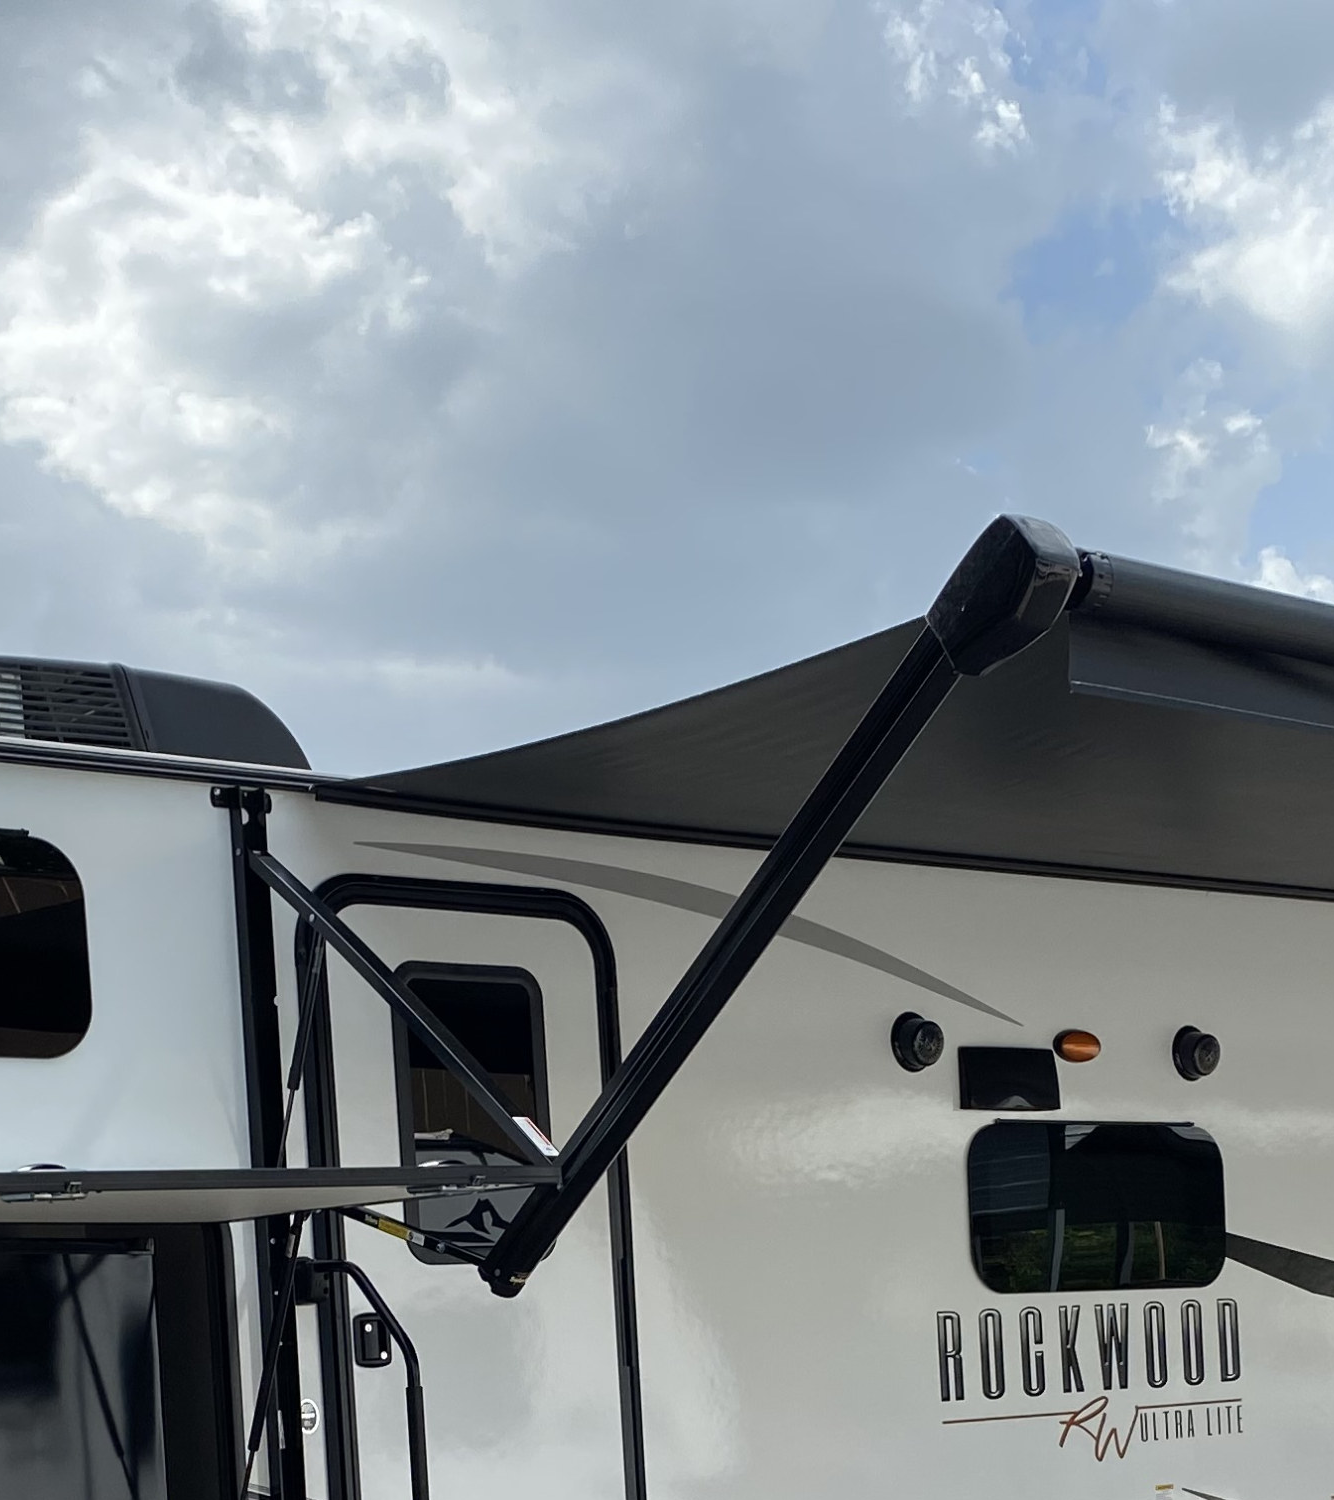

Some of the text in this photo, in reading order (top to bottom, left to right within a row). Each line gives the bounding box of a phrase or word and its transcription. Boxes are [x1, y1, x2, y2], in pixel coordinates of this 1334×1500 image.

[936, 1298, 1242, 1402] ROCKWOOD
[1139, 1404, 1244, 1442] ULTRA LITE
